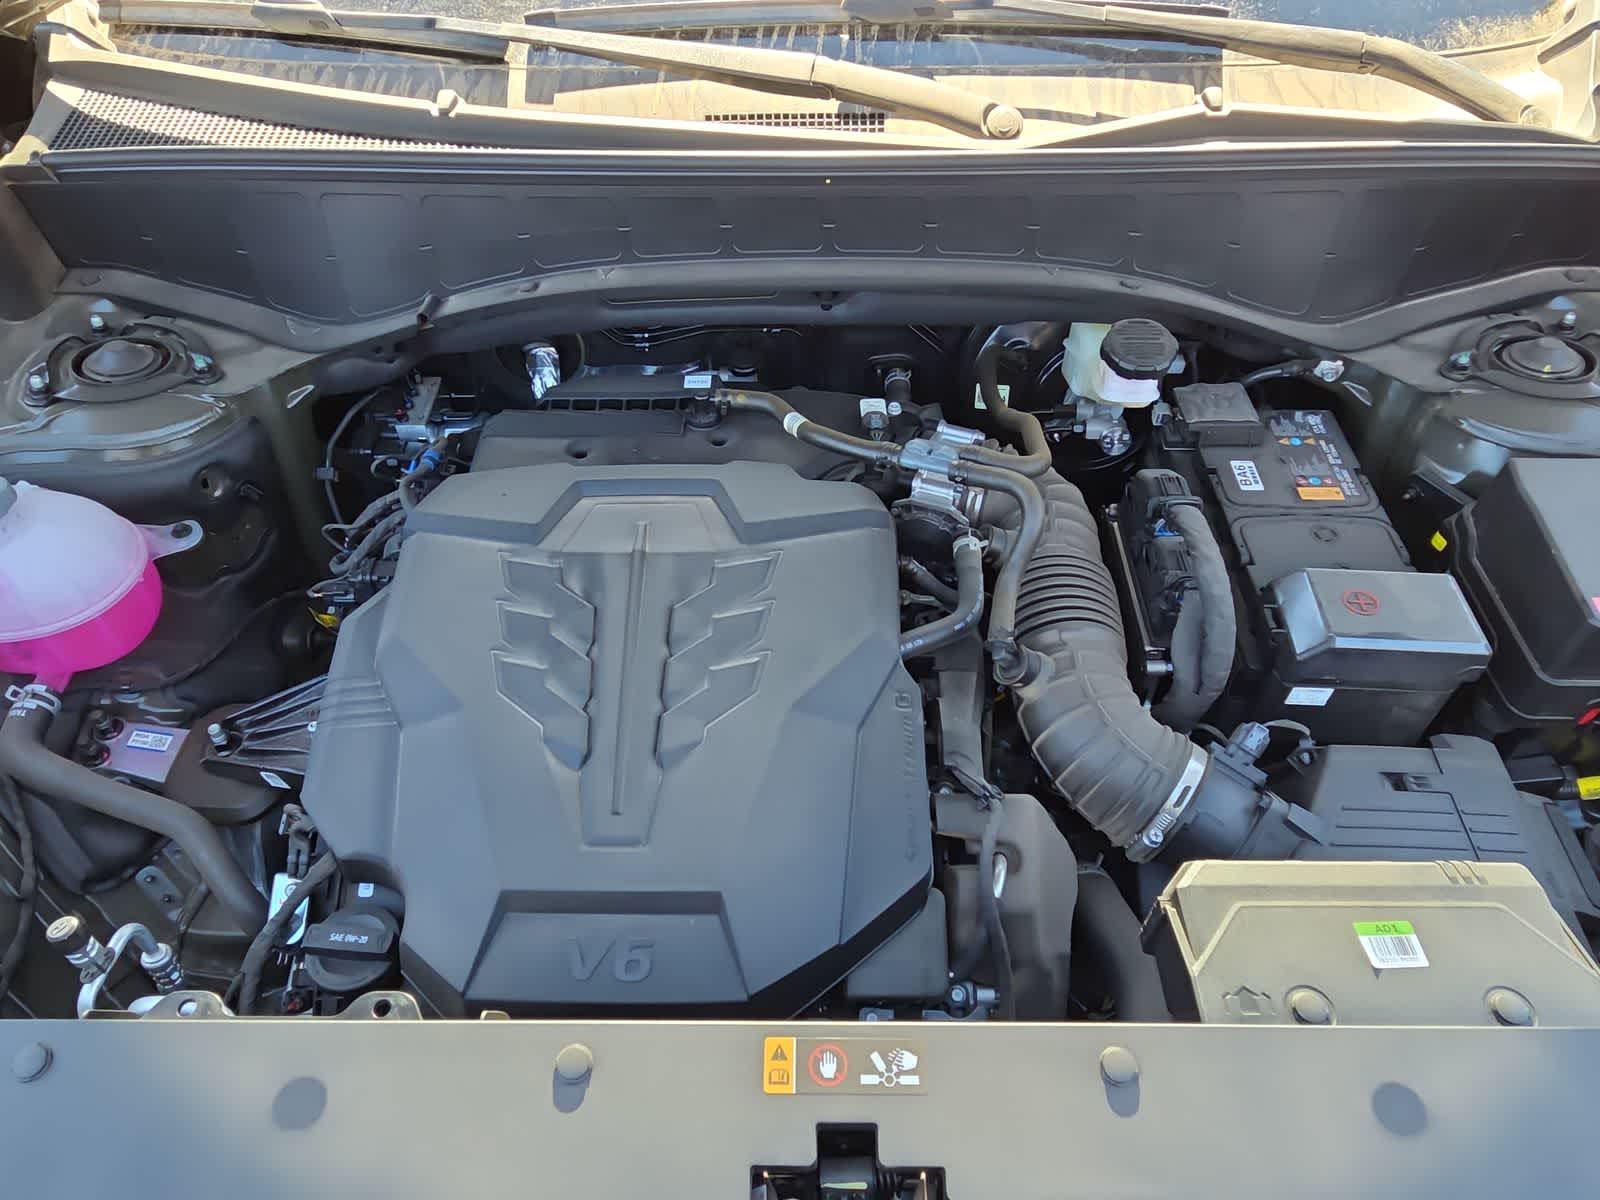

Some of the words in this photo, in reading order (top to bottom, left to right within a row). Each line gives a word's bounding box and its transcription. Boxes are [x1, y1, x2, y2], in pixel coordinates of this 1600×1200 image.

[1233, 464, 1253, 486] BA6
[328, 931, 345, 942] SAE
[568, 936, 656, 983] V6
